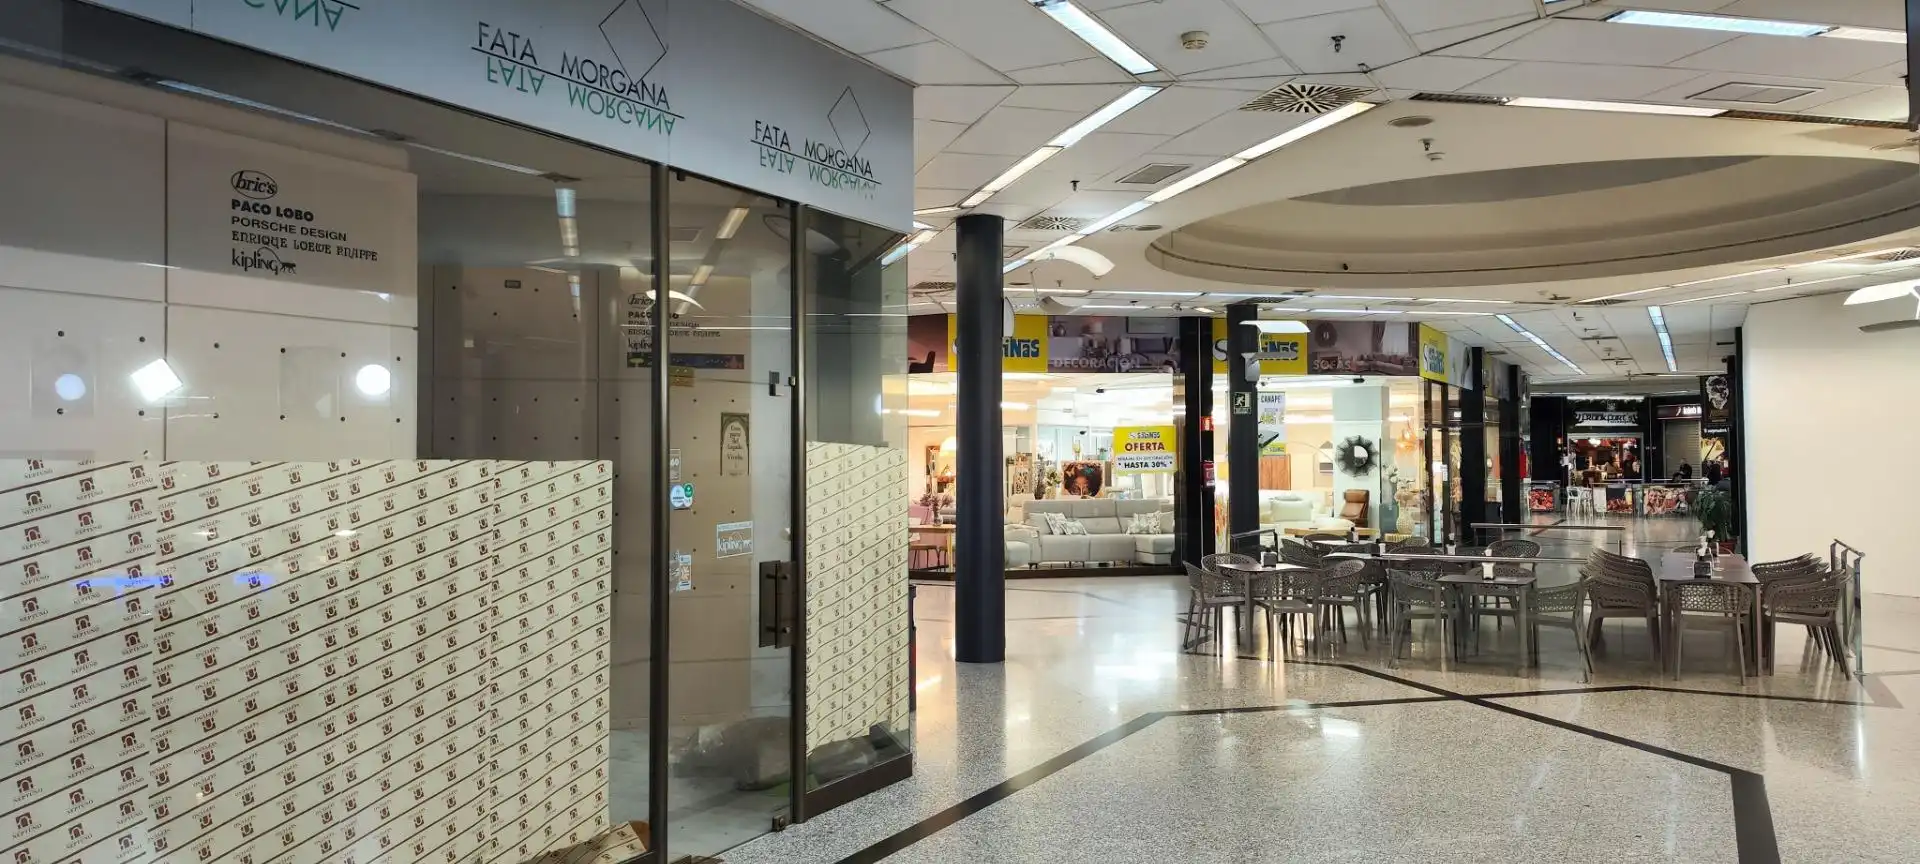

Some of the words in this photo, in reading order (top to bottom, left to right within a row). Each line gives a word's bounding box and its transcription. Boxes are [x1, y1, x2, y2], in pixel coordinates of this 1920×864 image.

[478, 21, 538, 66] FATA
[560, 51, 670, 110] MORGANA
[755, 119, 791, 151] FATA
[804, 138, 873, 179] MORGANA
[234, 170, 277, 196] bric's
[231, 199, 272, 216] PACO
[276, 206, 314, 222] LOBO
[231, 216, 297, 234] PORSCHE
[300, 226, 347, 242] DESIGN
[231, 230, 288, 250] ENRIQUE
[232, 248, 278, 276] kipling
[1124, 441, 1165, 451] OFERTA
[1124, 461, 1149, 469] HASTA
[1151, 460, 1167, 468] 30%
